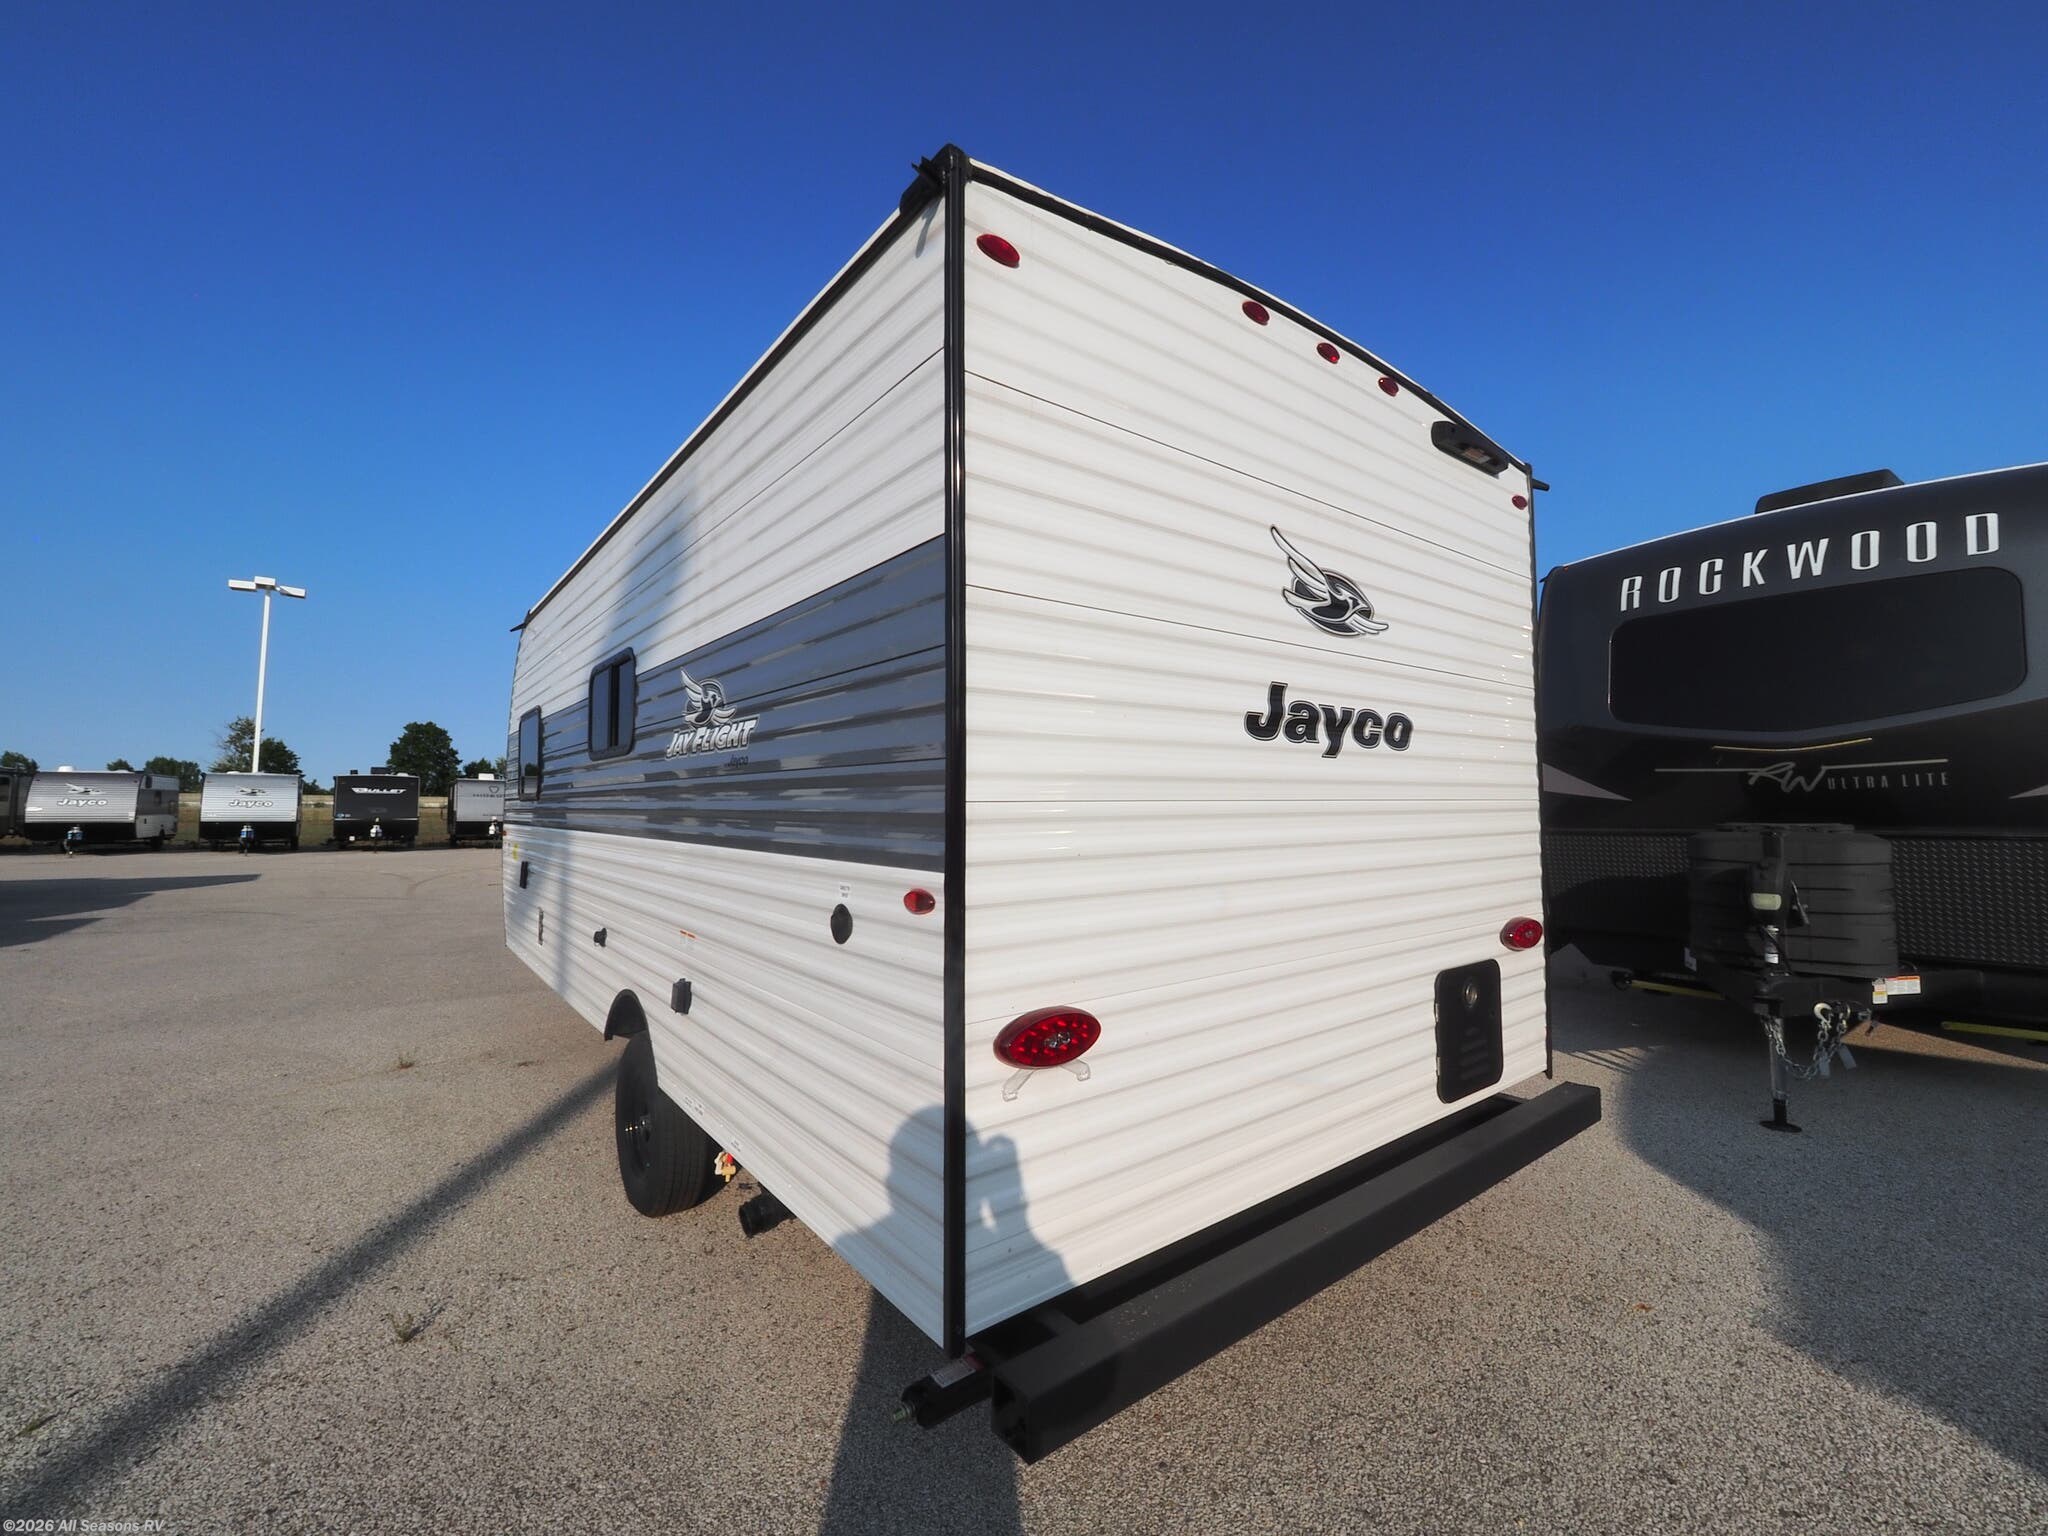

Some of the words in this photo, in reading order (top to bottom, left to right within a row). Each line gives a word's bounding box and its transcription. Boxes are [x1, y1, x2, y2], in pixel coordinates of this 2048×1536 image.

[1620, 512, 1999, 612] ROCKWOOD
[1243, 681, 1414, 758] Jayco
[666, 730, 694, 759] JAY
[692, 717, 758, 753] FLIGHT
[1828, 775, 1888, 790] ULTRA
[1902, 772, 1949, 787] LITE
[57, 798, 108, 807] Jayco
[229, 799, 273, 808] Jayco
